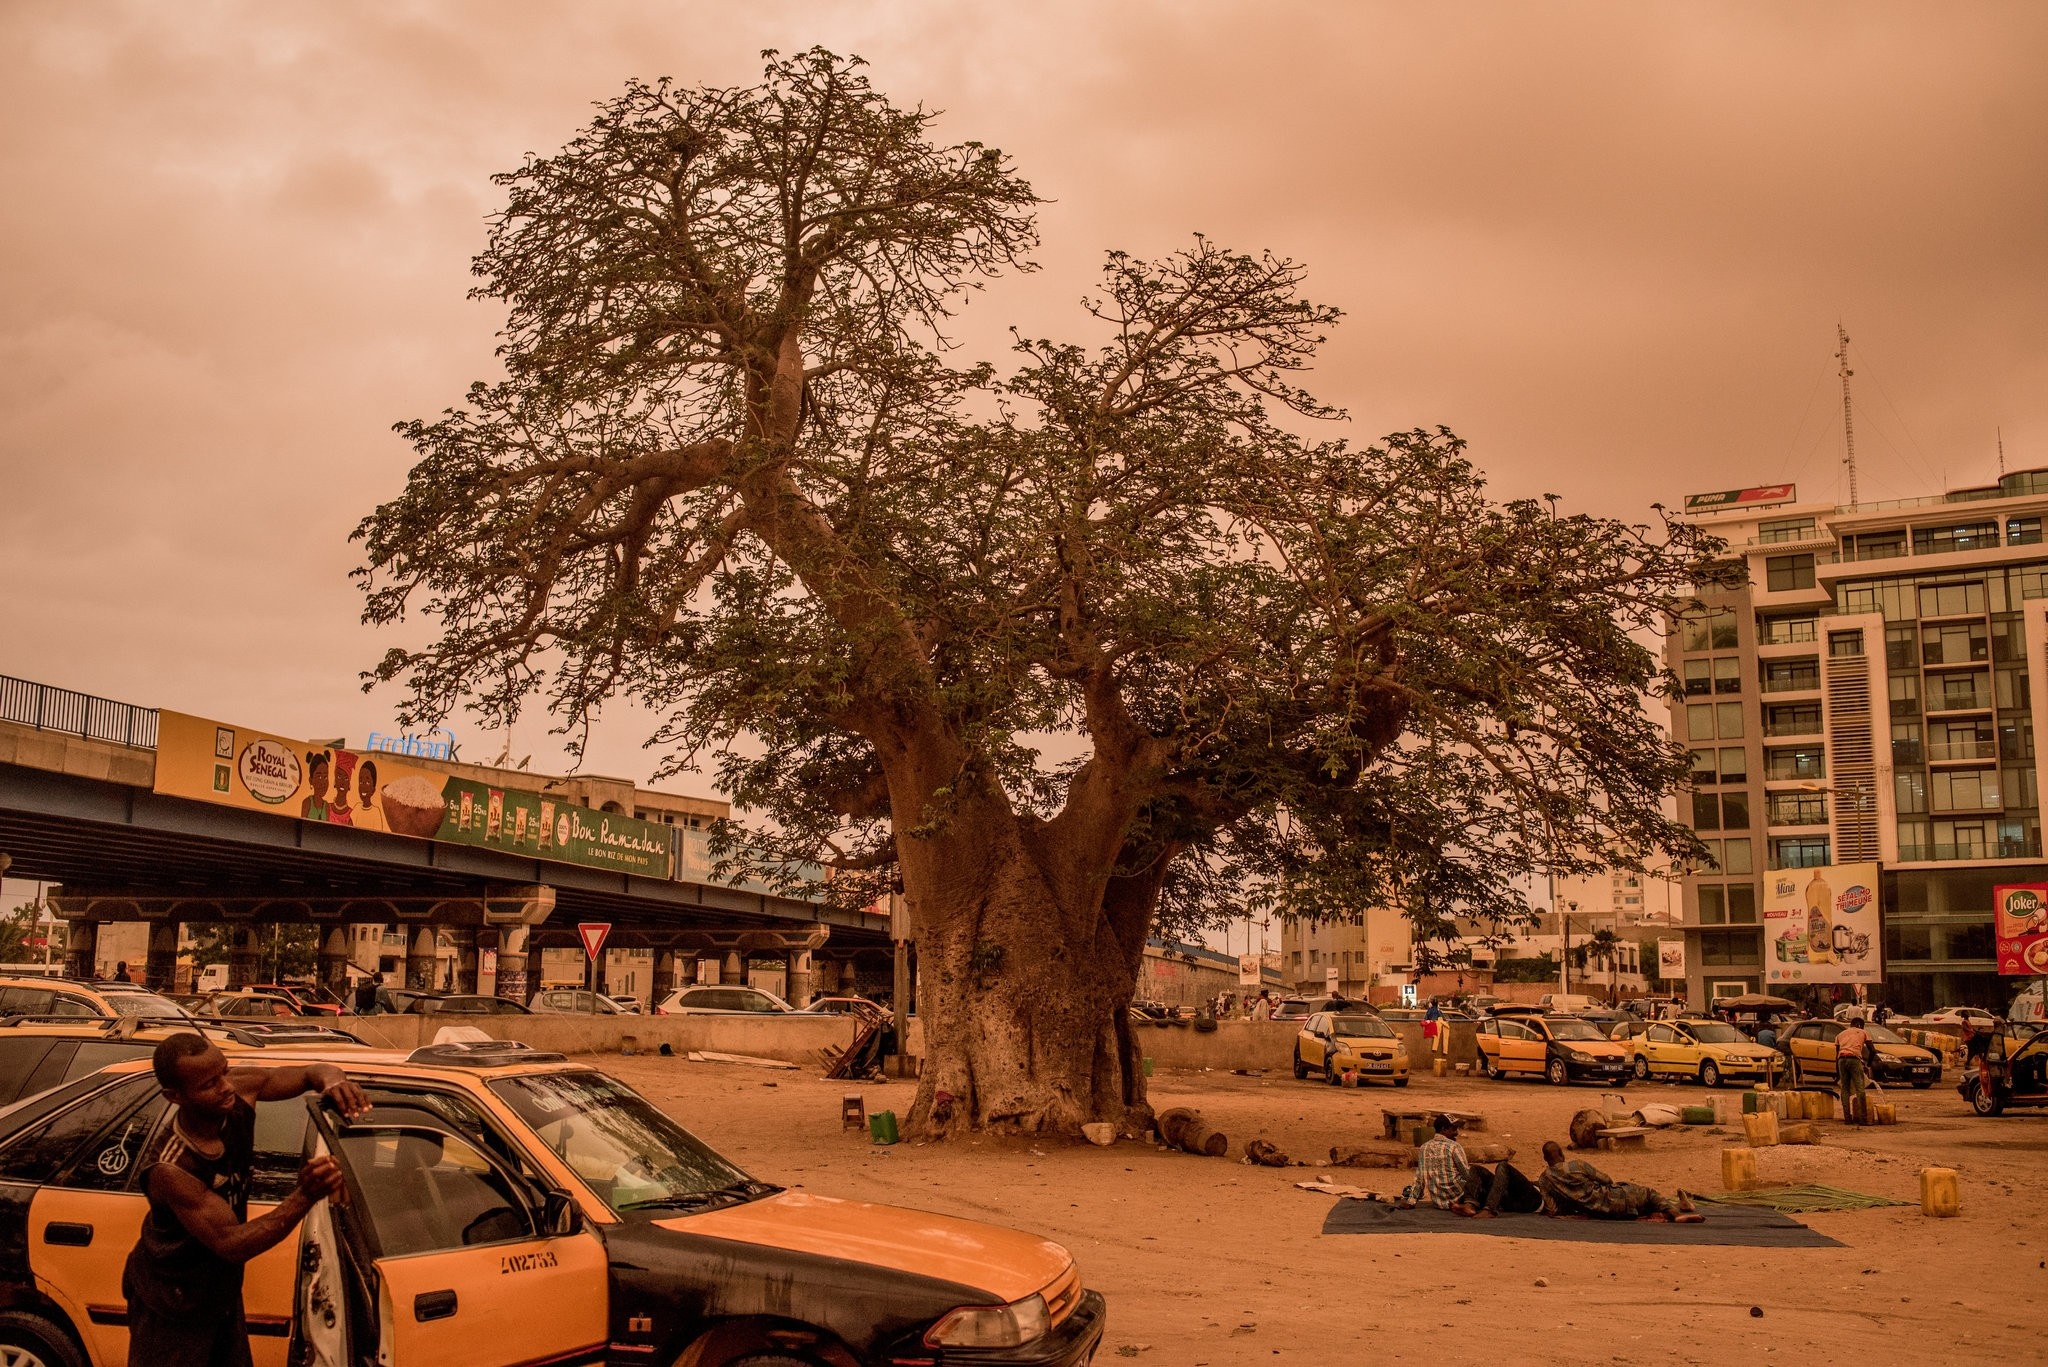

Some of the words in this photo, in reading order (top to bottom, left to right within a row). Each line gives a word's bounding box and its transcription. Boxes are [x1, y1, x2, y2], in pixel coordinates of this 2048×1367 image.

[1696, 493, 1726, 504] PUMA
[257, 745, 286, 768] ROYAL
[366, 727, 462, 763] Ecobank
[249, 755, 288, 780] SENEGAL
[572, 811, 596, 842] Bon
[600, 818, 665, 855] Ramadan
[588, 847, 594, 856] LE
[594, 849, 607, 858] BON
[607, 850, 616, 860] RIZ
[616, 852, 624, 861] DE
[624, 854, 637, 863] MON
[637, 856, 648, 866] PAYS
[2009, 895, 2037, 913] Joker
